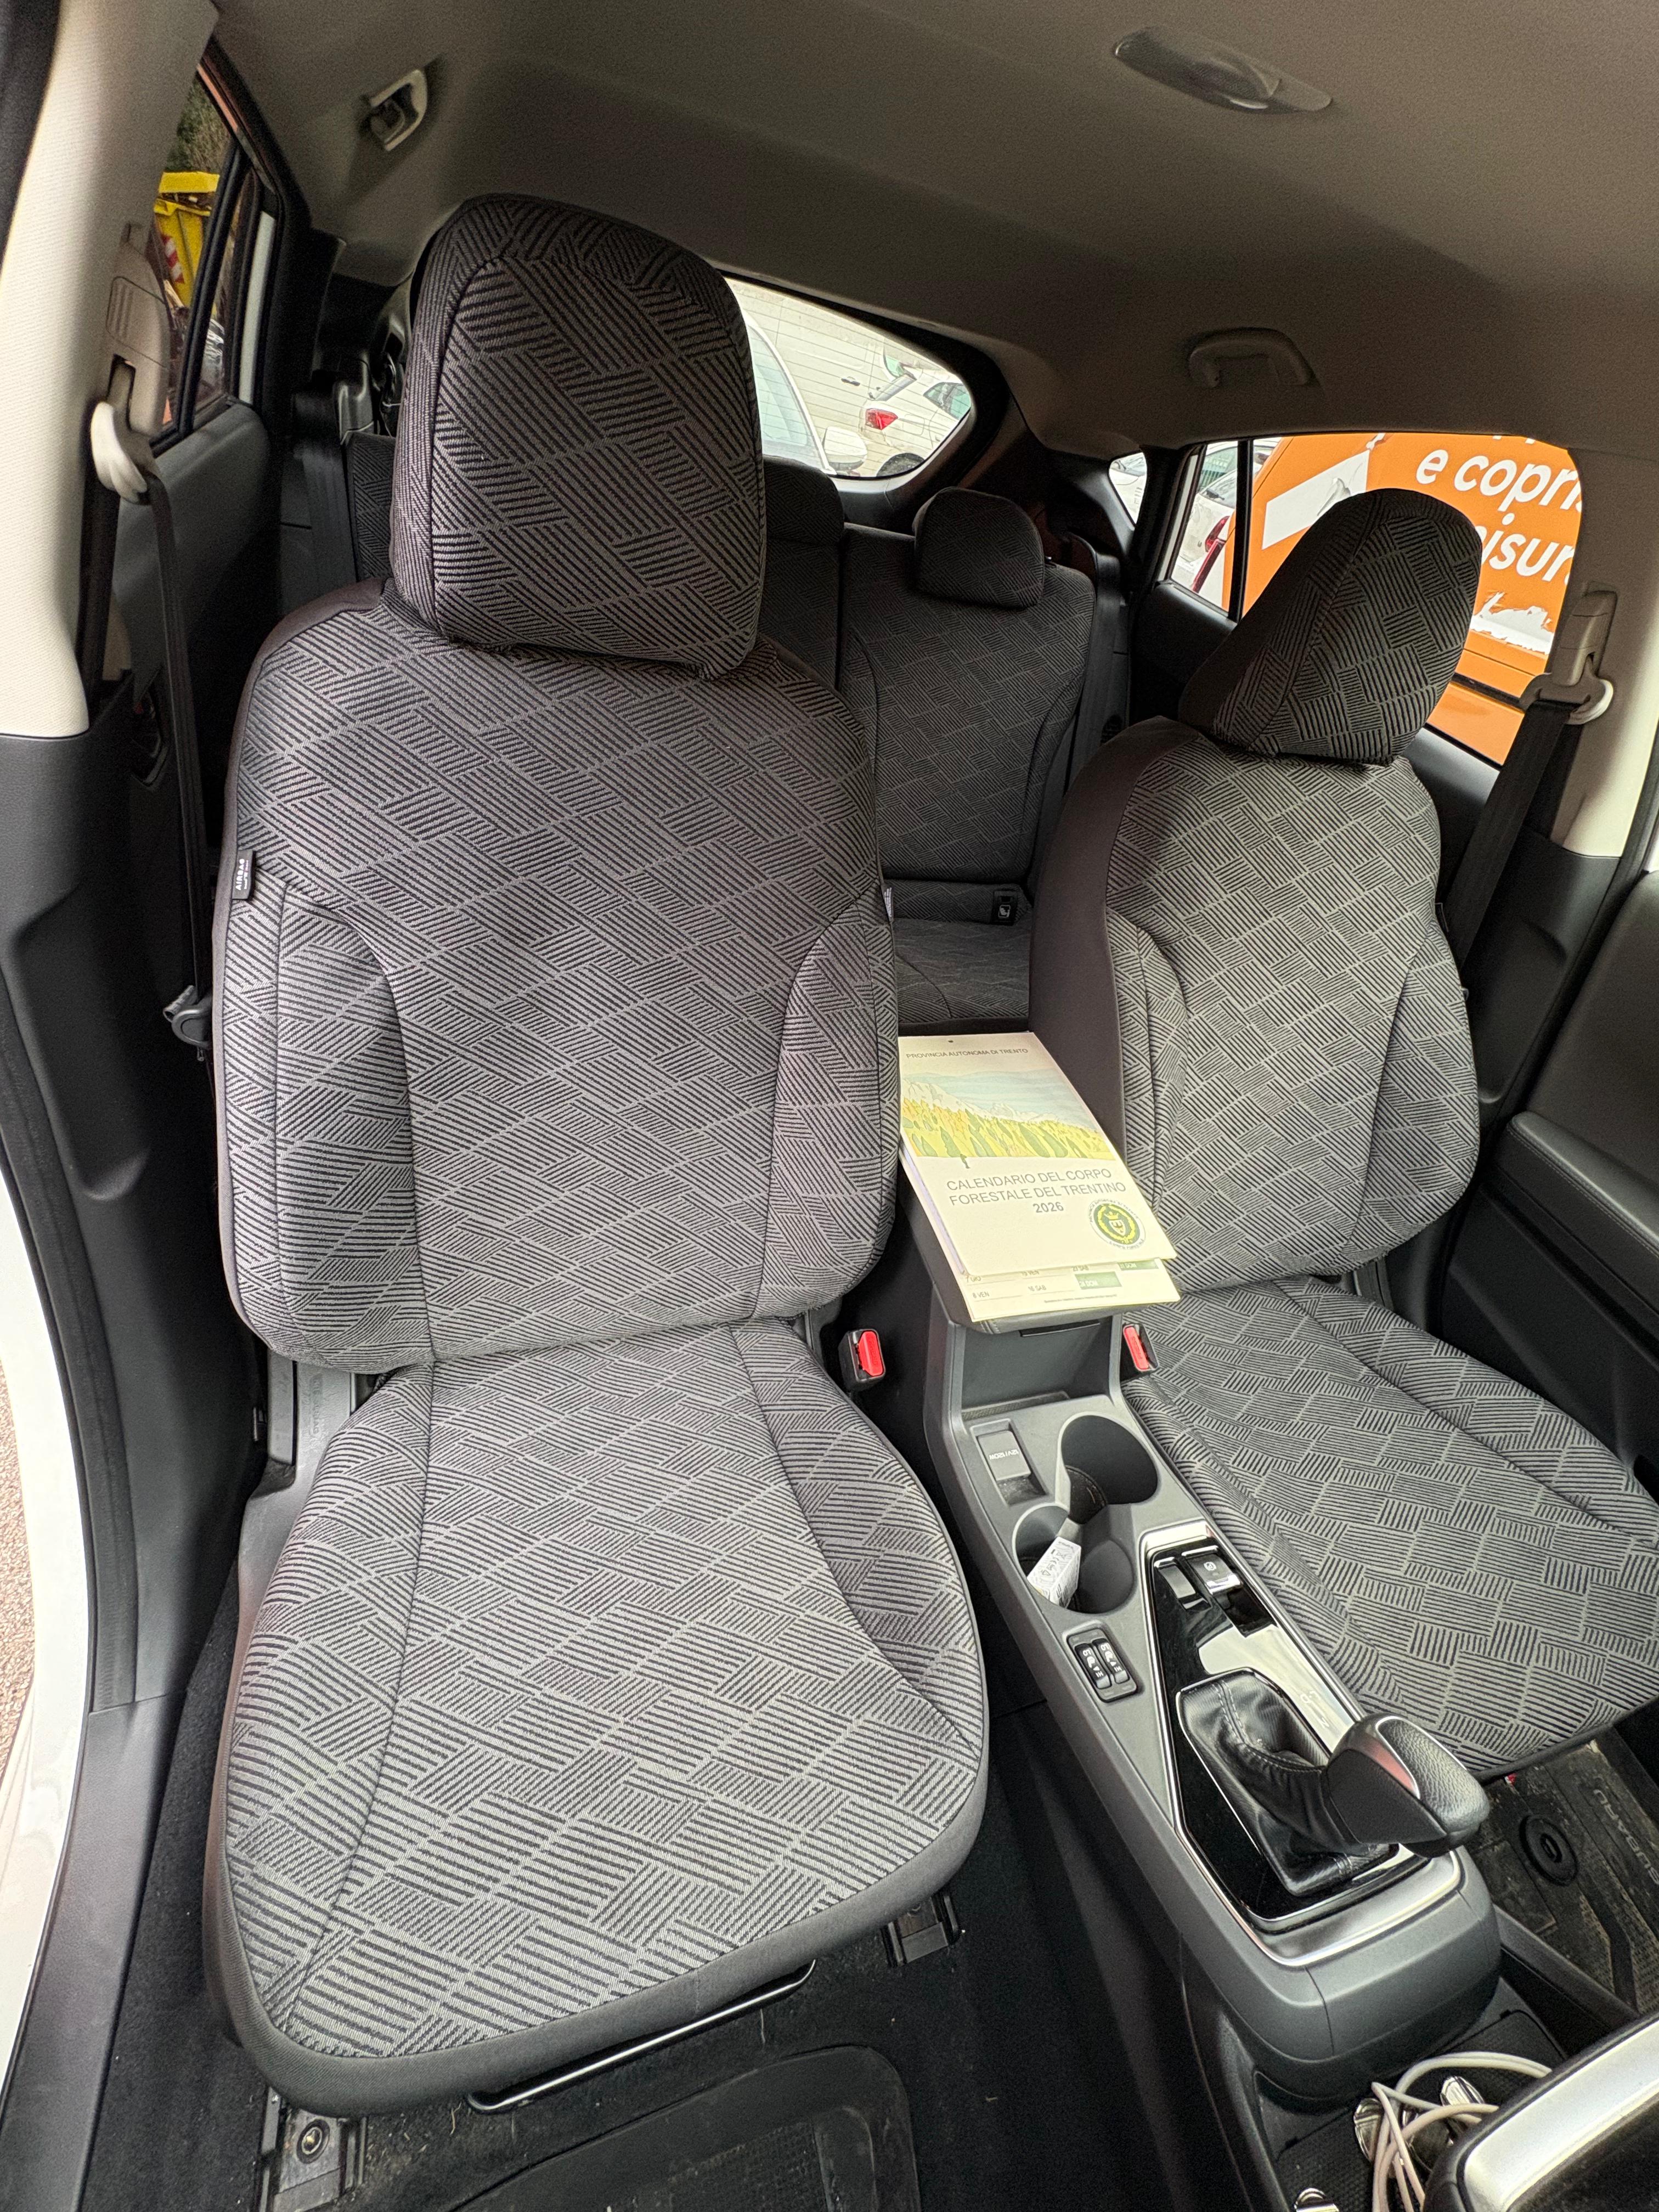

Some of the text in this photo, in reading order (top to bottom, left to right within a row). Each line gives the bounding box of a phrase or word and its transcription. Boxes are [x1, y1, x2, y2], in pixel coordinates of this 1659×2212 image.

[1416, 449, 1449, 484] e
[947, 1168, 1111, 1190] CALENDARIO DEL CORPO
[949, 1182, 1126, 1206] FORESTALE DEL TRENTINO
[1033, 1201, 1064, 1214] 2026
[1594, 1789, 1659, 1885] SUBARU
